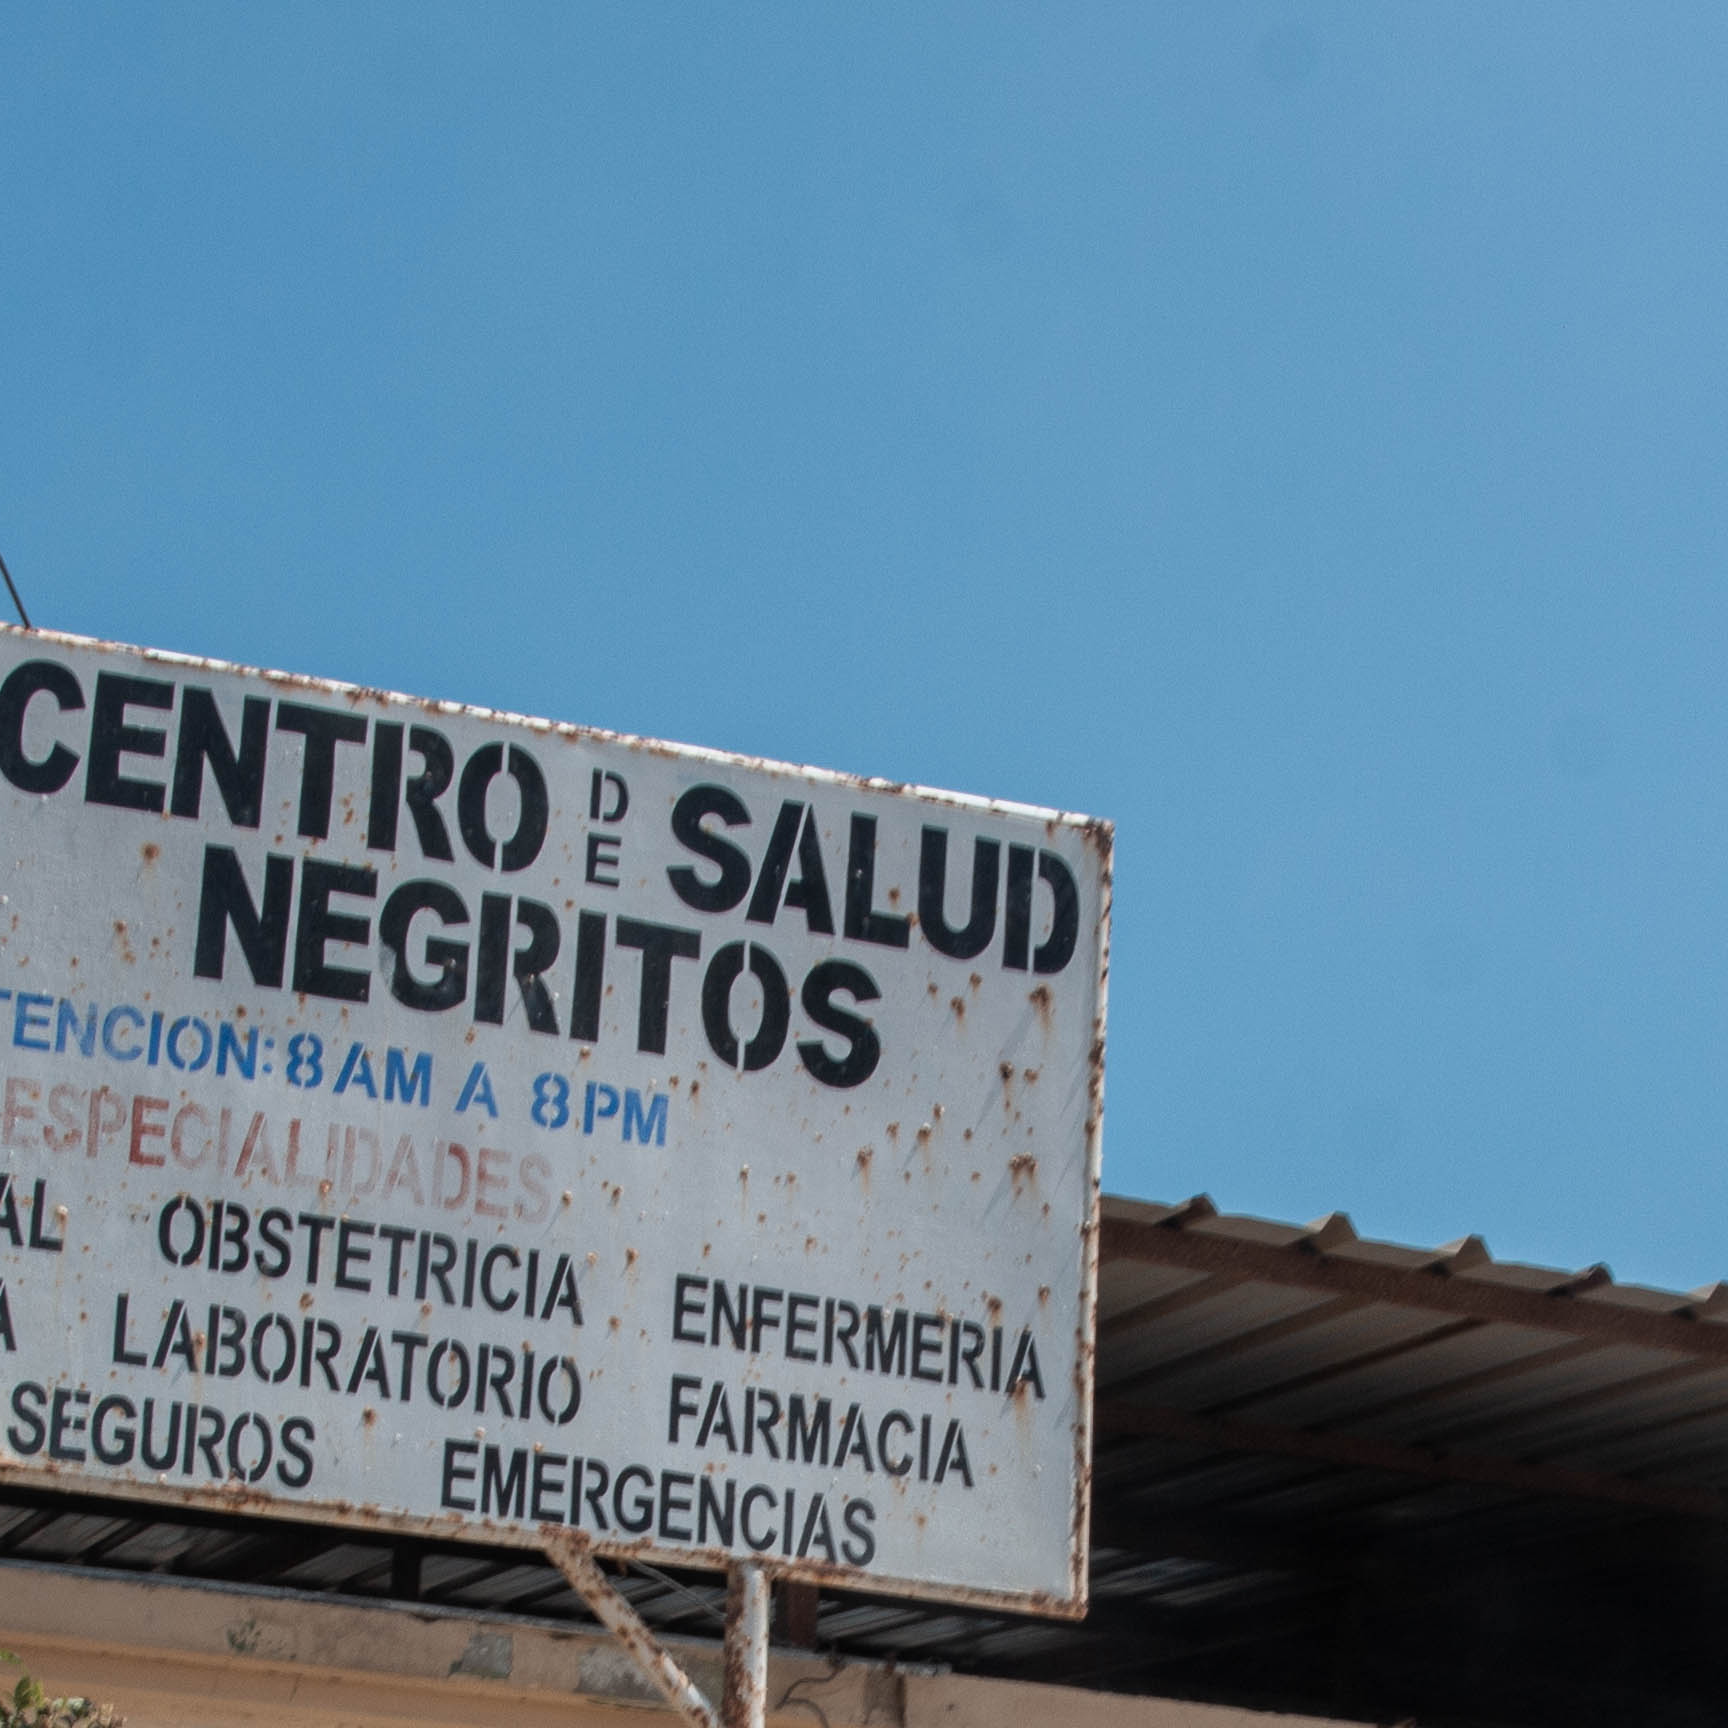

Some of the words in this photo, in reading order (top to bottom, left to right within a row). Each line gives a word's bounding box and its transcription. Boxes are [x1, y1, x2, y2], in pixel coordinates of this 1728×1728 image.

[585, 768, 629, 888] DE
[666, 783, 1080, 976] SALUD
[193, 844, 882, 1088] NEGRITOS
[2, 1077, 555, 1225] ESPECIALIDADES
[455, 1061, 499, 1119] A
[531, 1072, 670, 1147] 8PM
[158, 1195, 584, 1326] OBSTETRICIA
[112, 1292, 582, 1426] LABORATORIO
[673, 1273, 1046, 1400] ENFERMERIA
[8, 1381, 316, 1489] SEGUROS
[668, 1374, 974, 1487] FARMACIA
[440, 1438, 877, 1567] EMERGENCIAS
